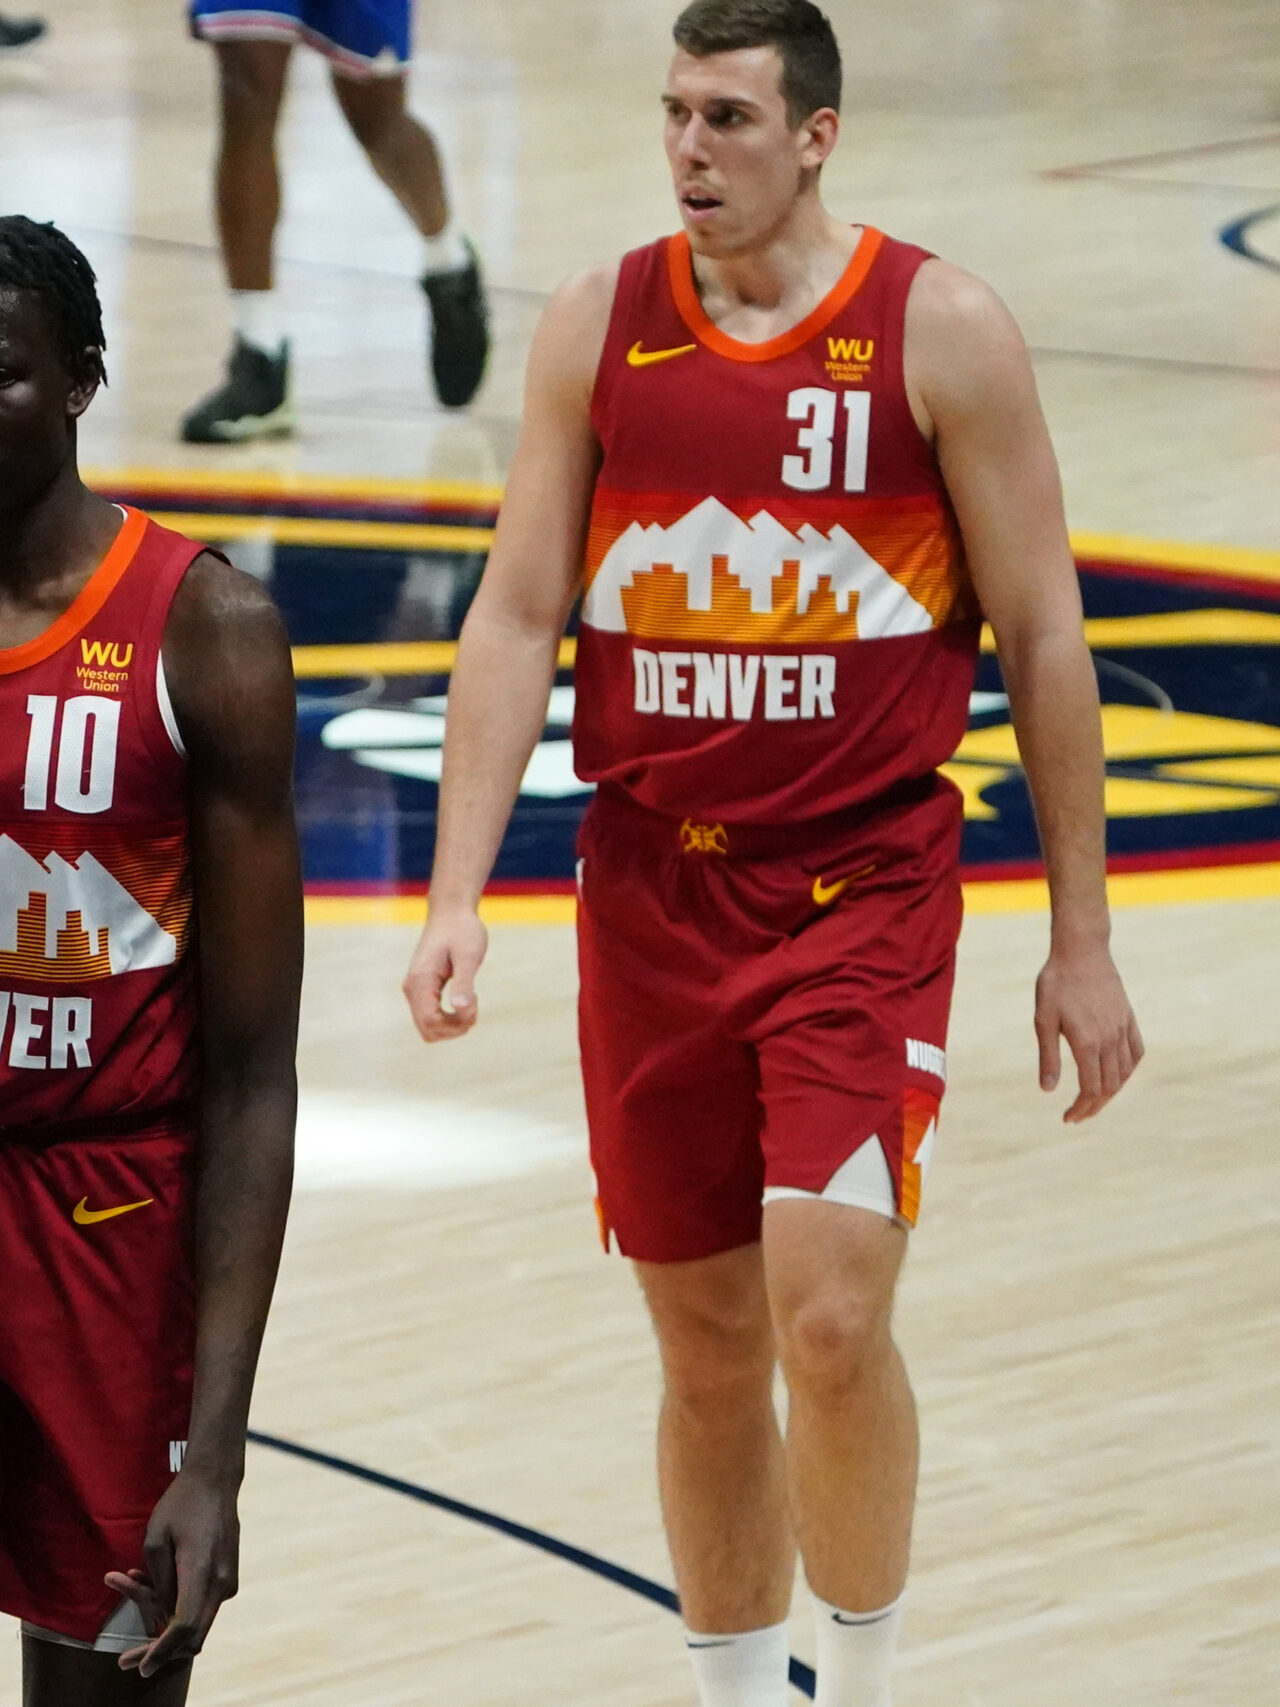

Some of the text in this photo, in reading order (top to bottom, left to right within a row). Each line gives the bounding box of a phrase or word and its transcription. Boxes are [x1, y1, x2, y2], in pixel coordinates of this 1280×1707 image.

[827, 336, 874, 361] WU
[781, 386, 871, 493] 31
[80, 638, 133, 668] WU
[76, 666, 128, 681] Western
[83, 680, 119, 693] Union
[632, 647, 836, 722] DENVER
[23, 694, 122, 814] 10
